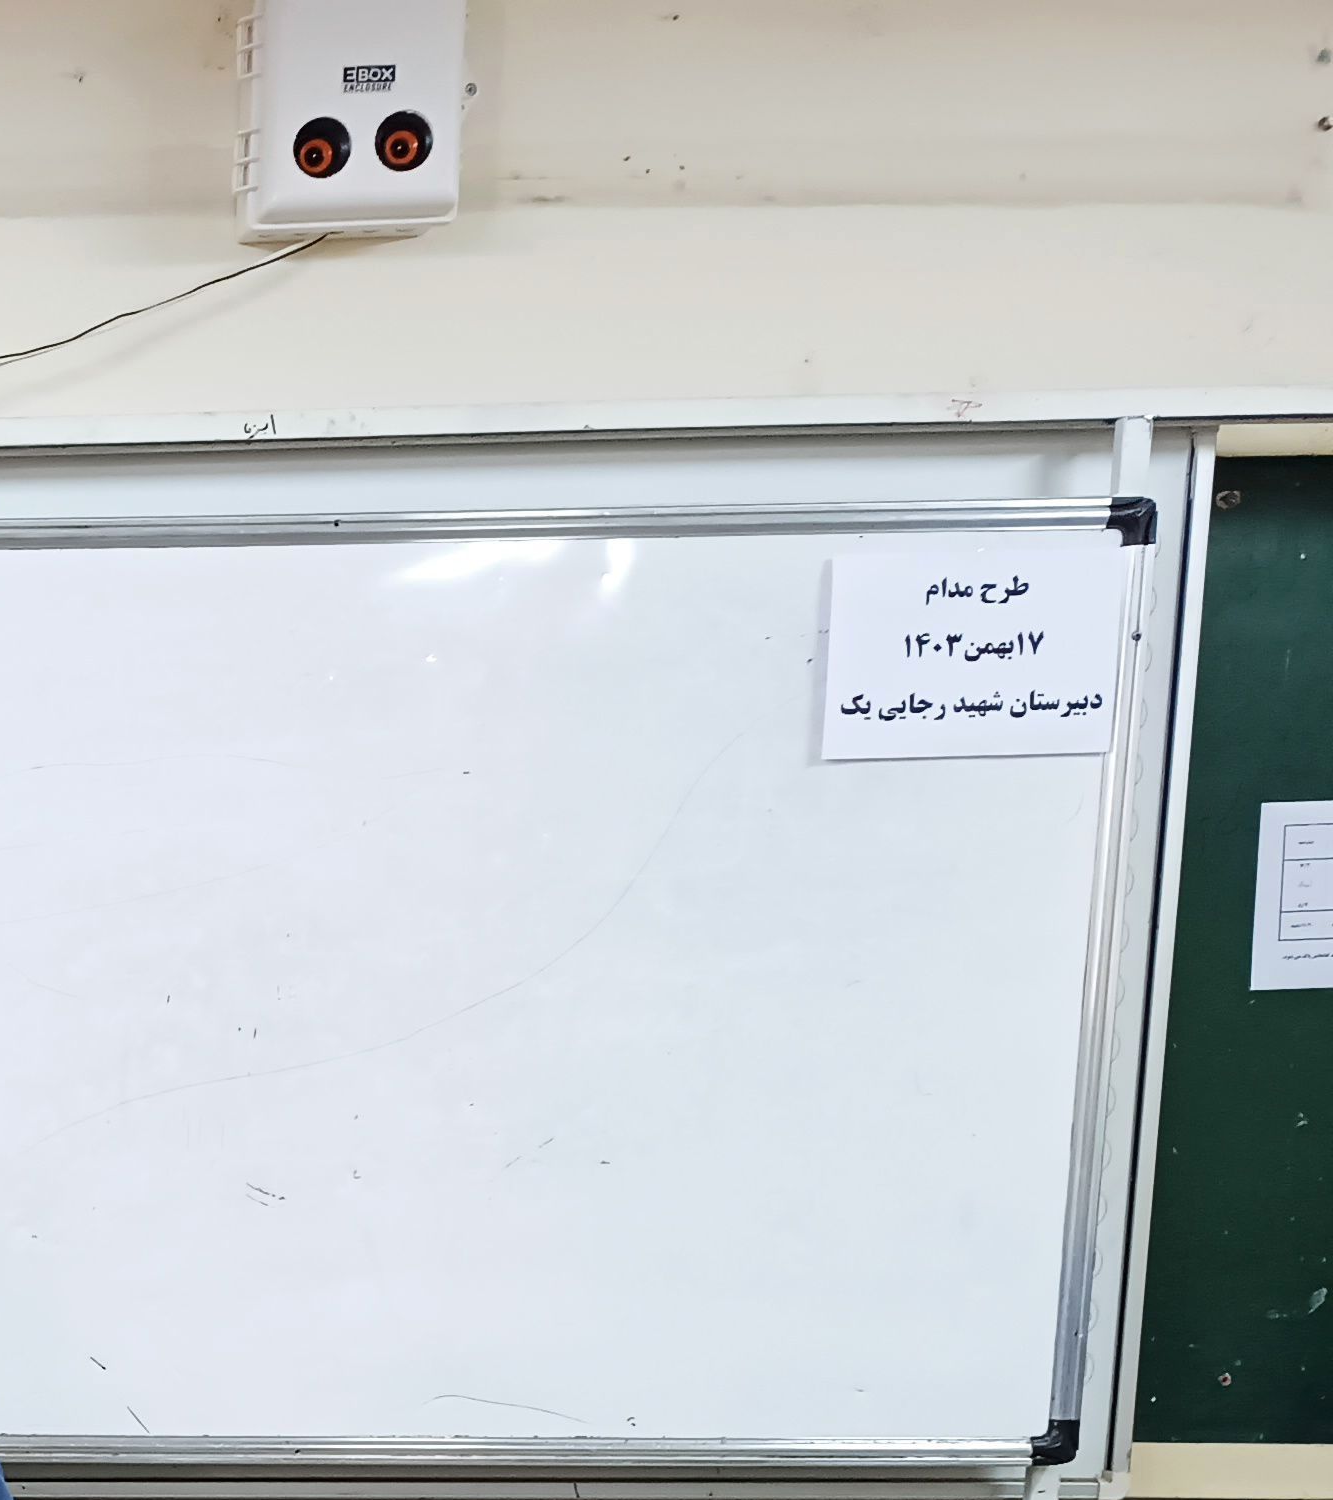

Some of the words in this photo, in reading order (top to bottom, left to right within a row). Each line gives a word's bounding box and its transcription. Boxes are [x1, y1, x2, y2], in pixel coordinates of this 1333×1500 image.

[343, 65, 396, 82] EBOX
[925, 576, 973, 605] مدام
[980, 575, 1029, 603] طرح
[840, 695, 871, 720] یک
[878, 693, 946, 721] رجایی
[953, 692, 1004, 717] شهید
[1009, 690, 1103, 718] دبیرستان
